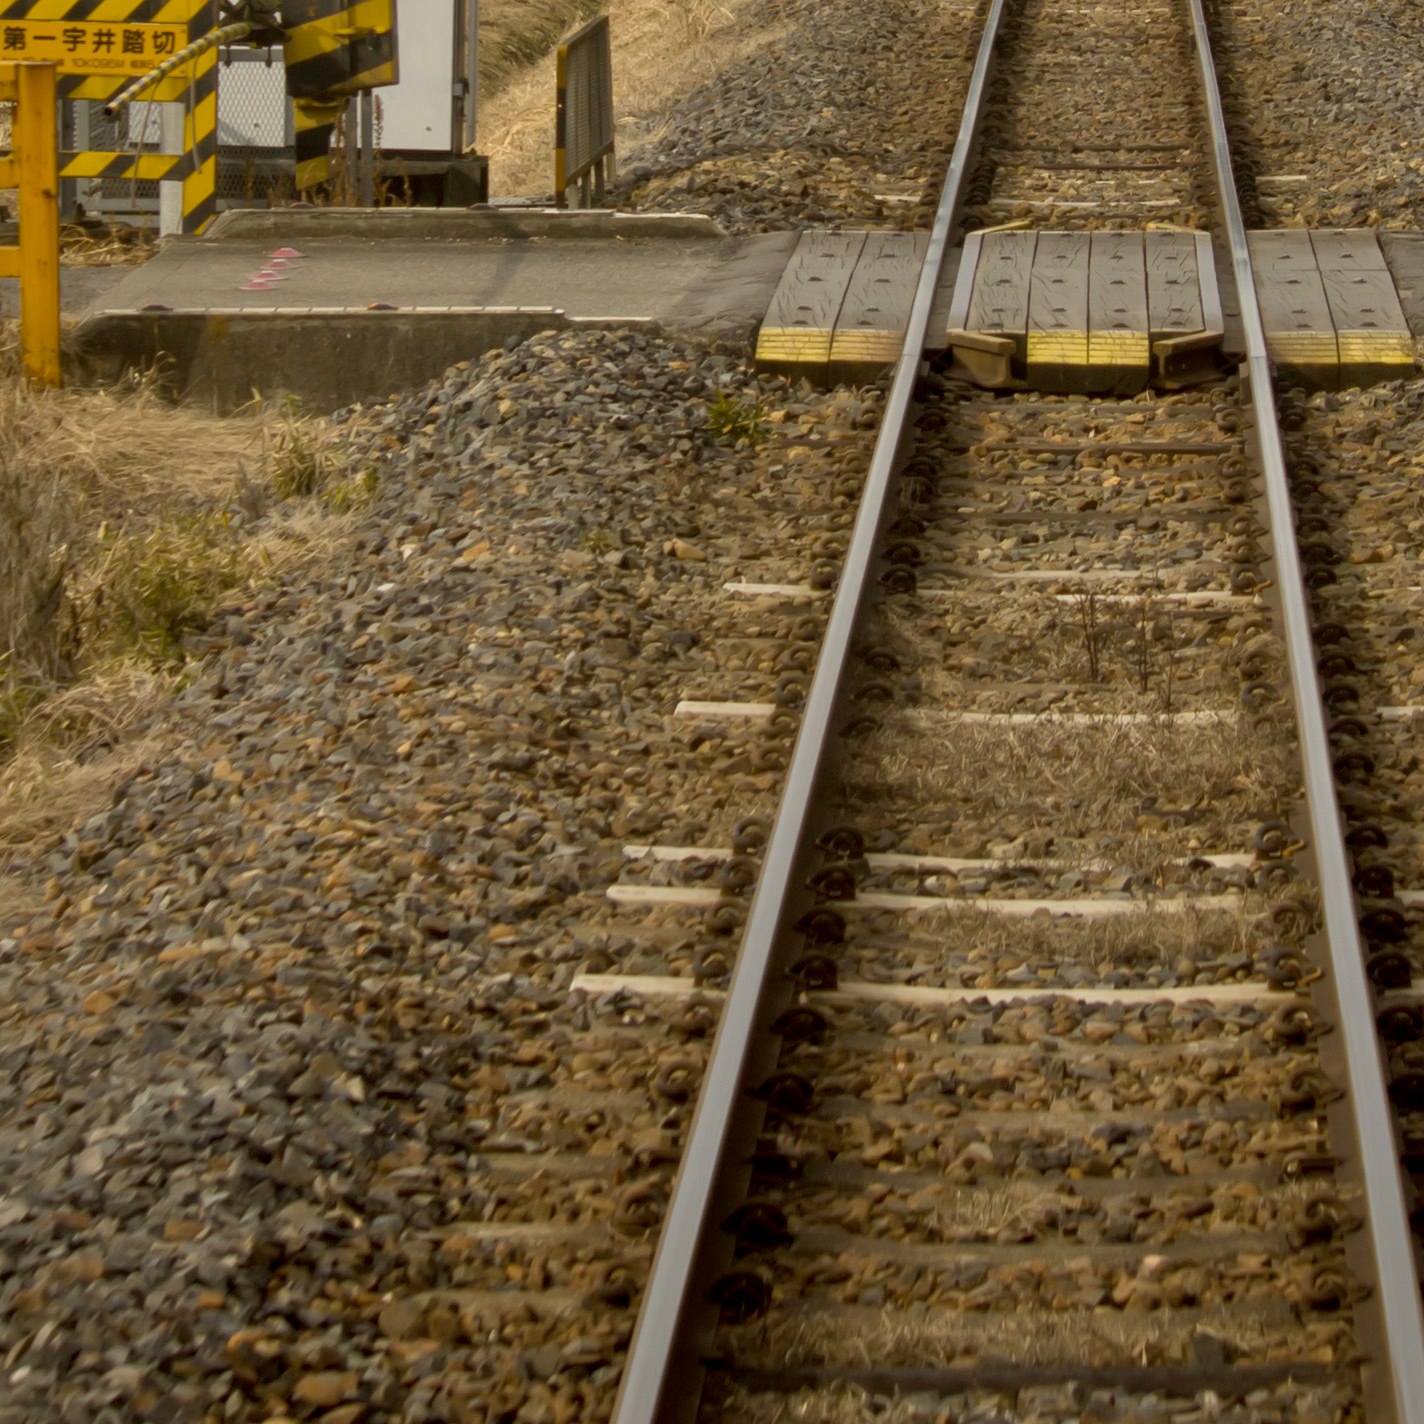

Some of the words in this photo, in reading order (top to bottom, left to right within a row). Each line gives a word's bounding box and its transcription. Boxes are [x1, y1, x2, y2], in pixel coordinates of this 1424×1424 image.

[3, 26, 176, 55] 第一宇井踏切
